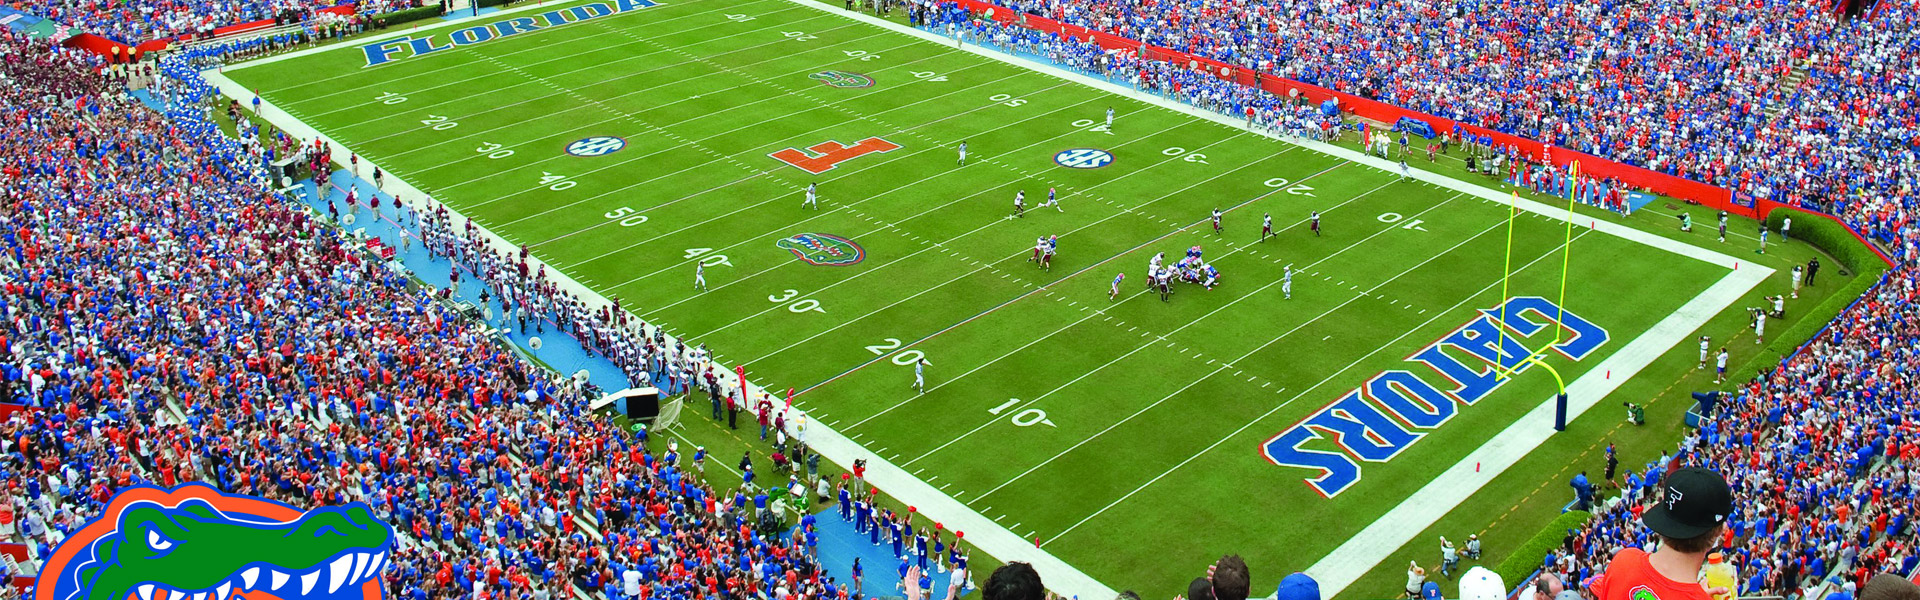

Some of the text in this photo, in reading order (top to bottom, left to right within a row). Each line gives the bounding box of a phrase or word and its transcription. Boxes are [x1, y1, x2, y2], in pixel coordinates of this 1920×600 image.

[729, 13, 756, 23] 10
[786, 31, 817, 42] 20
[849, 50, 880, 61] 30
[914, 70, 948, 83] 40
[375, 93, 408, 105] 10
[989, 93, 1027, 107] 50
[421, 116, 458, 131] 20
[476, 143, 515, 159] 30
[1162, 147, 1206, 163] 30
[539, 173, 577, 191] 40
[1264, 178, 1311, 195] 20
[604, 207, 648, 227] 50
[1377, 212, 1422, 230] 10
[684, 247, 728, 267] 40
[768, 289, 820, 313] 30
[865, 338, 926, 366] 20
[1258, 296, 1611, 499] GATORS
[987, 398, 1047, 427] 10
